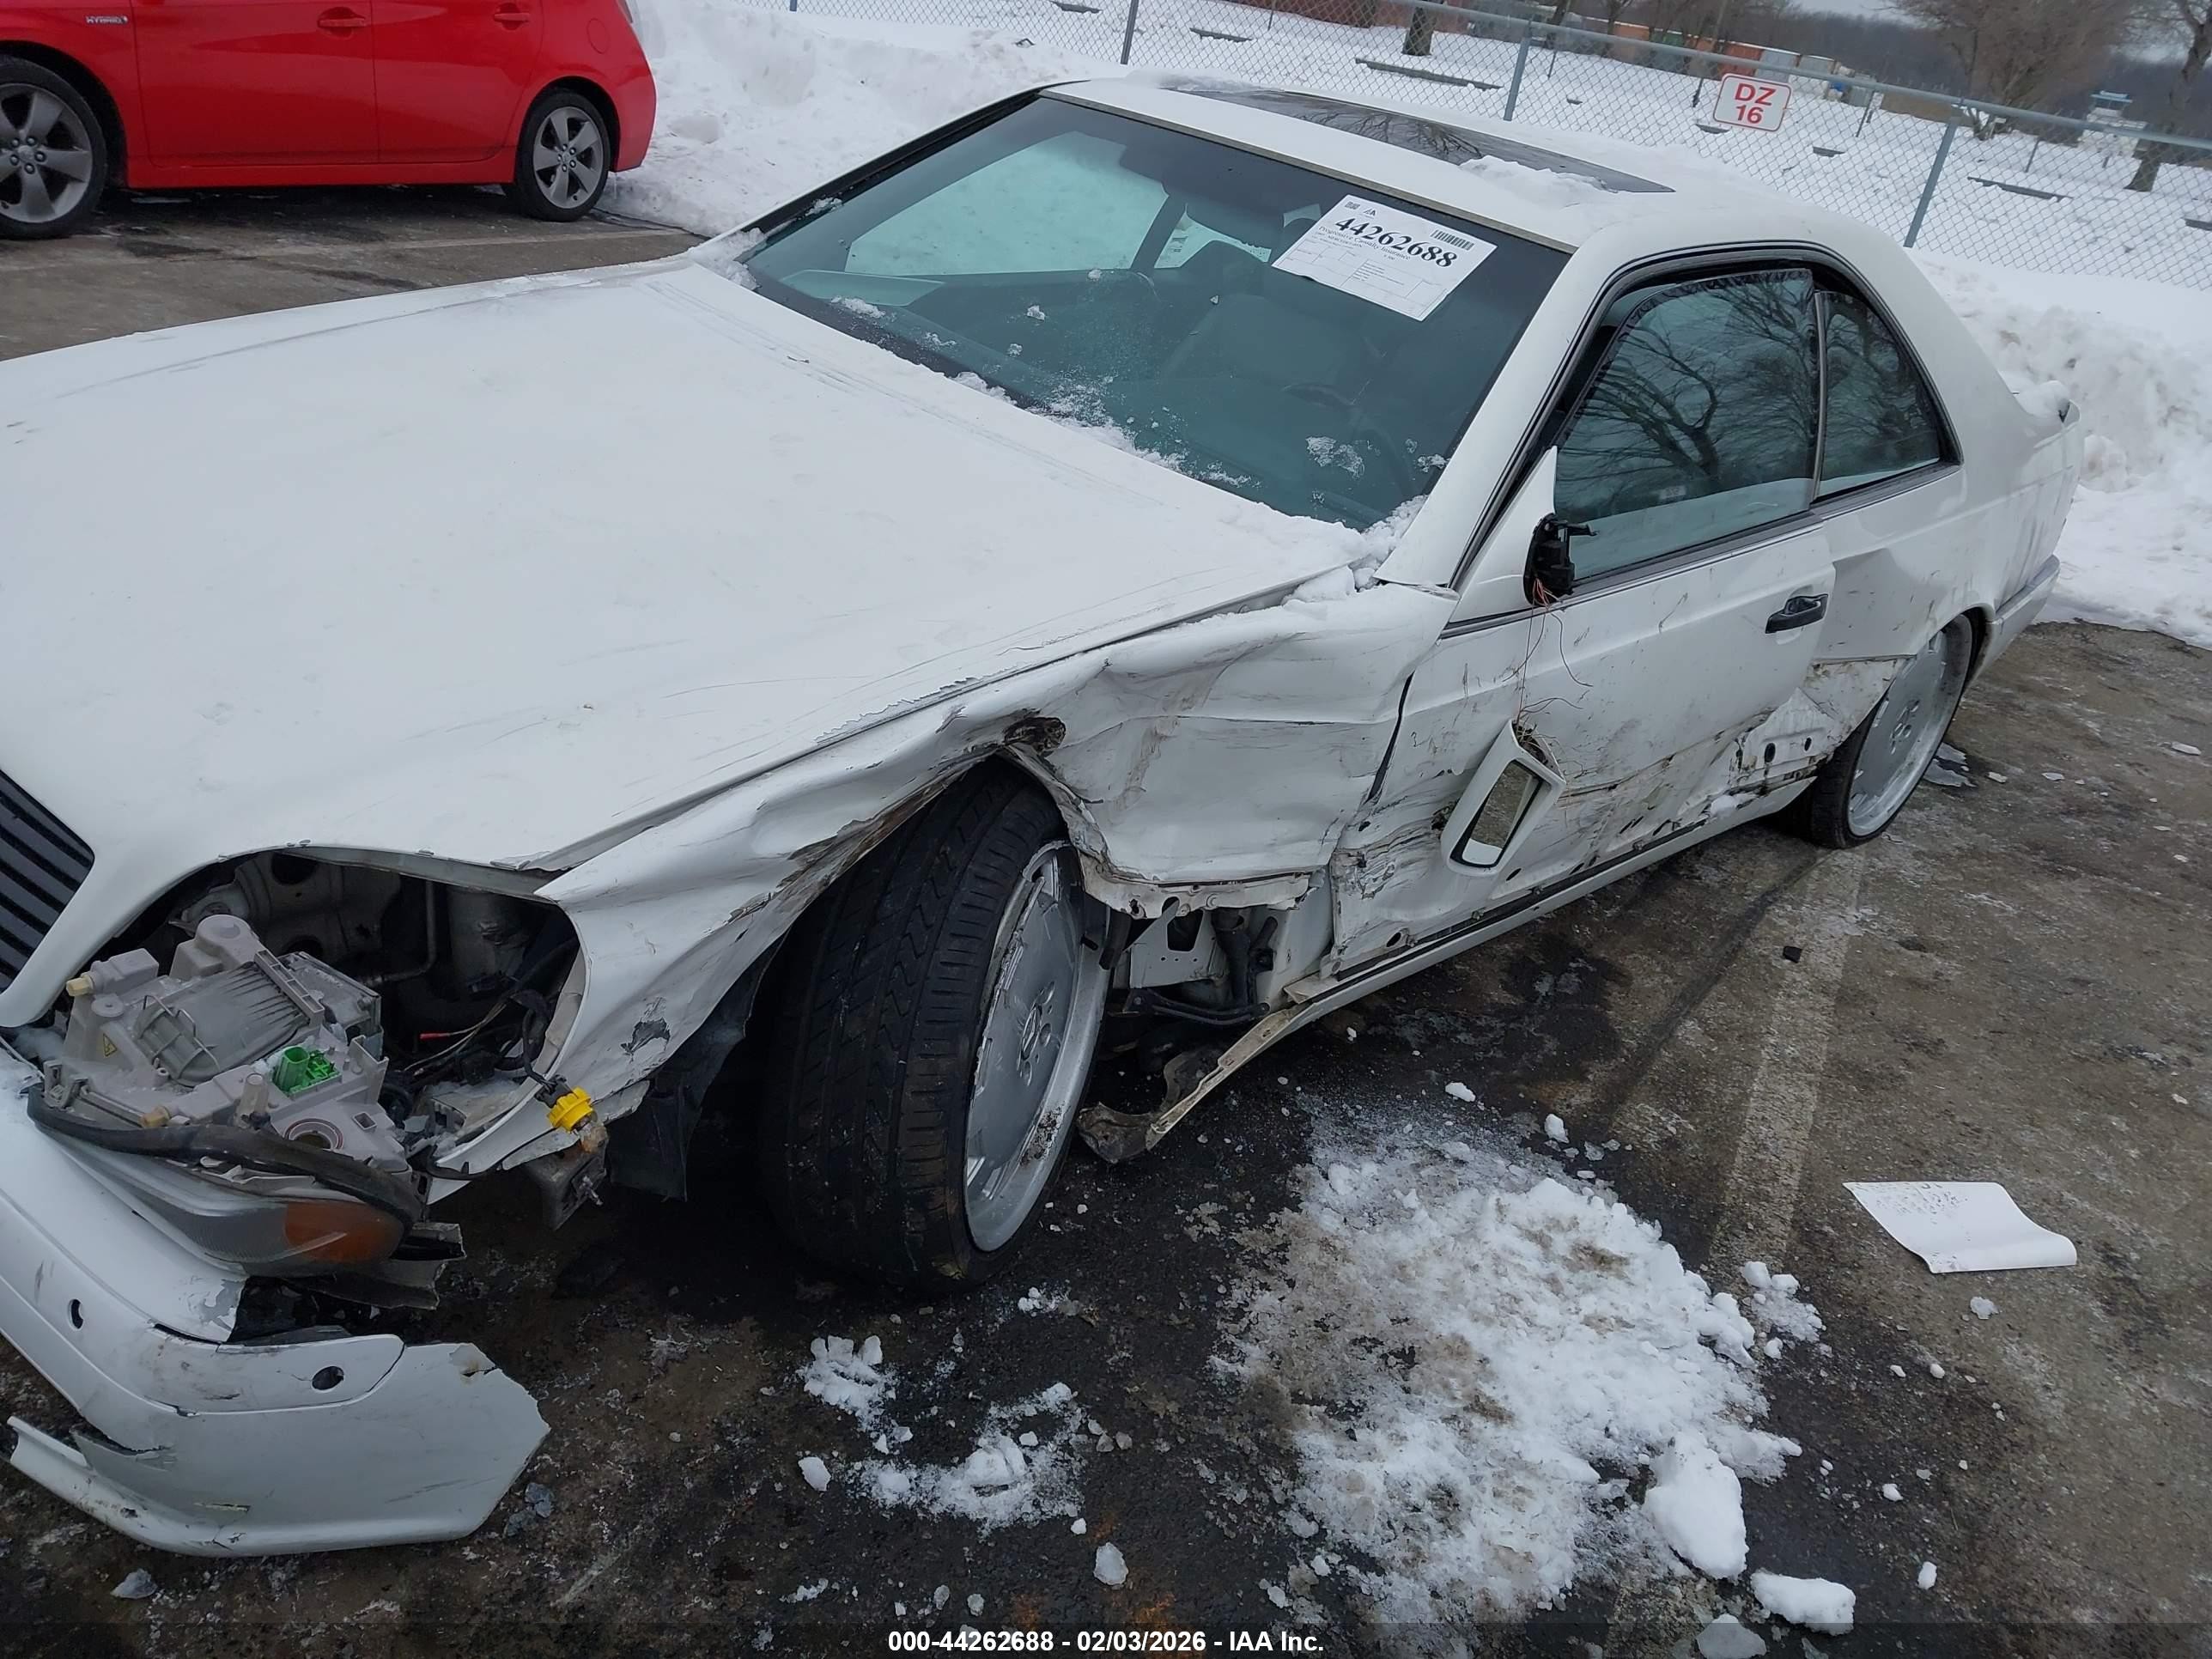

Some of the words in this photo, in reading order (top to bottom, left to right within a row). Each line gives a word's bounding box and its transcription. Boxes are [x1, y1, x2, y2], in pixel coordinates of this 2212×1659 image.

[1735, 83, 1777, 106] DZ
[1735, 105, 1764, 124] 16
[1335, 218, 1457, 267] 44262688
